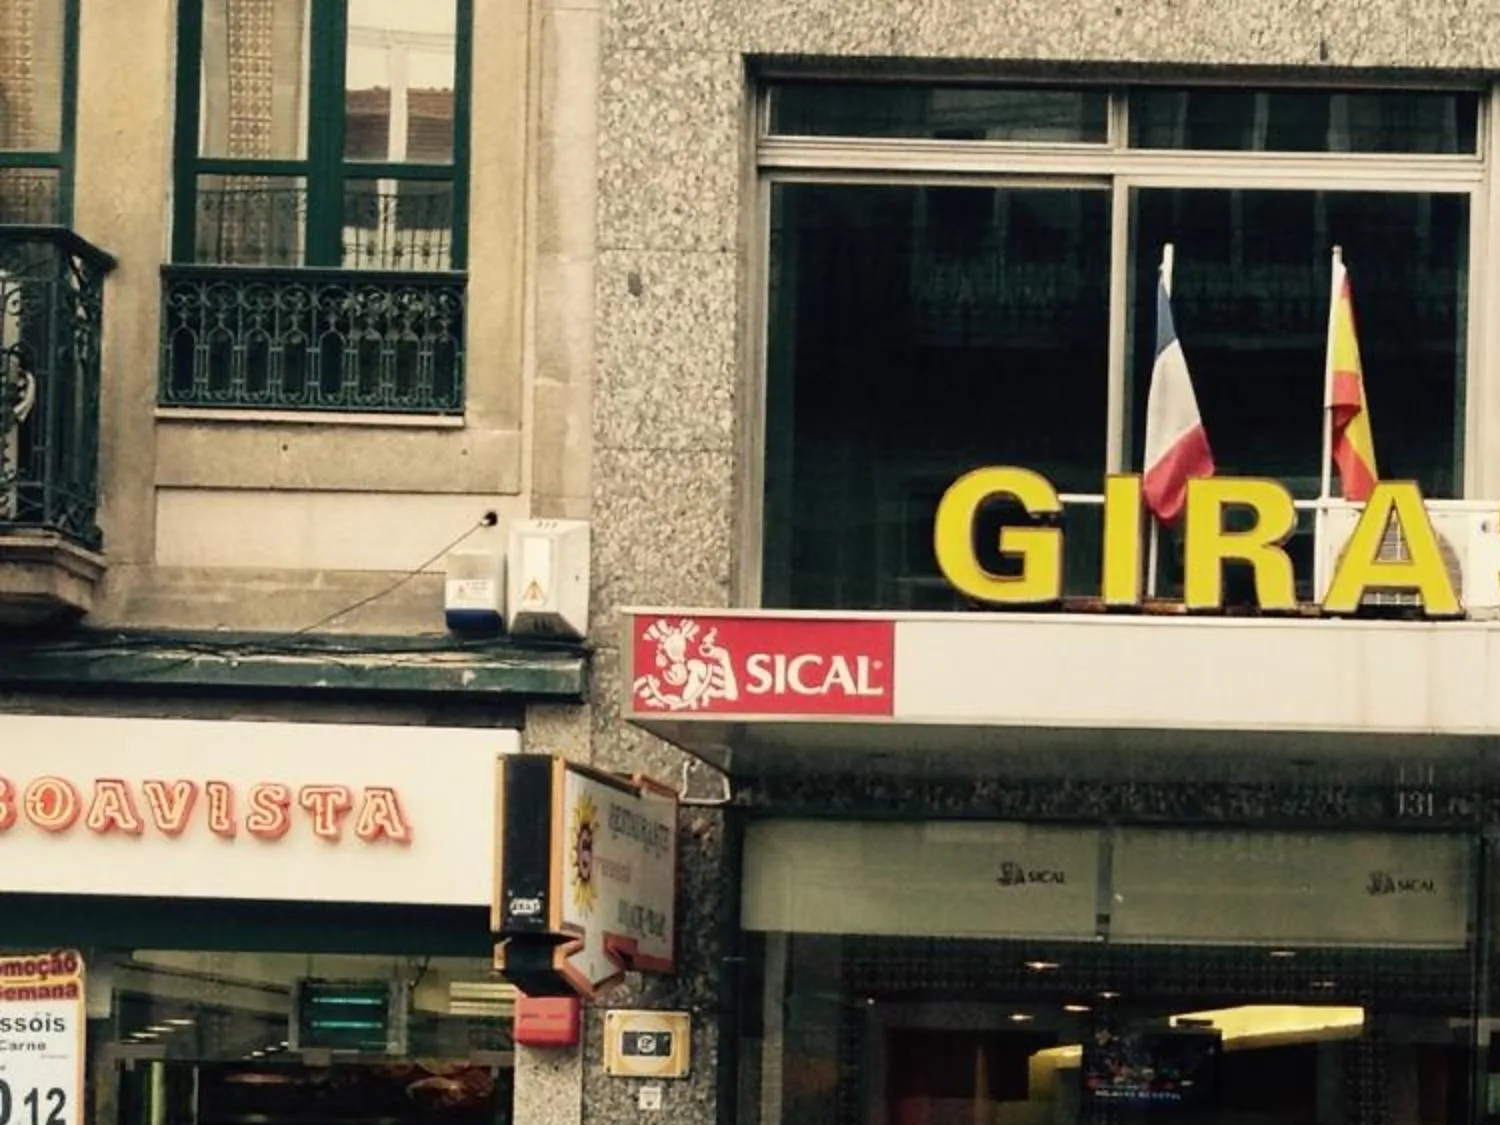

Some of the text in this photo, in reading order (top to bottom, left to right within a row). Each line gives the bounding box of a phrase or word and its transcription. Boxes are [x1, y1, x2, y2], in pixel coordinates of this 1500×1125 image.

[746, 653, 884, 695] SICAL
[0, 951, 78, 979] moção
[0, 982, 79, 1000] emana
